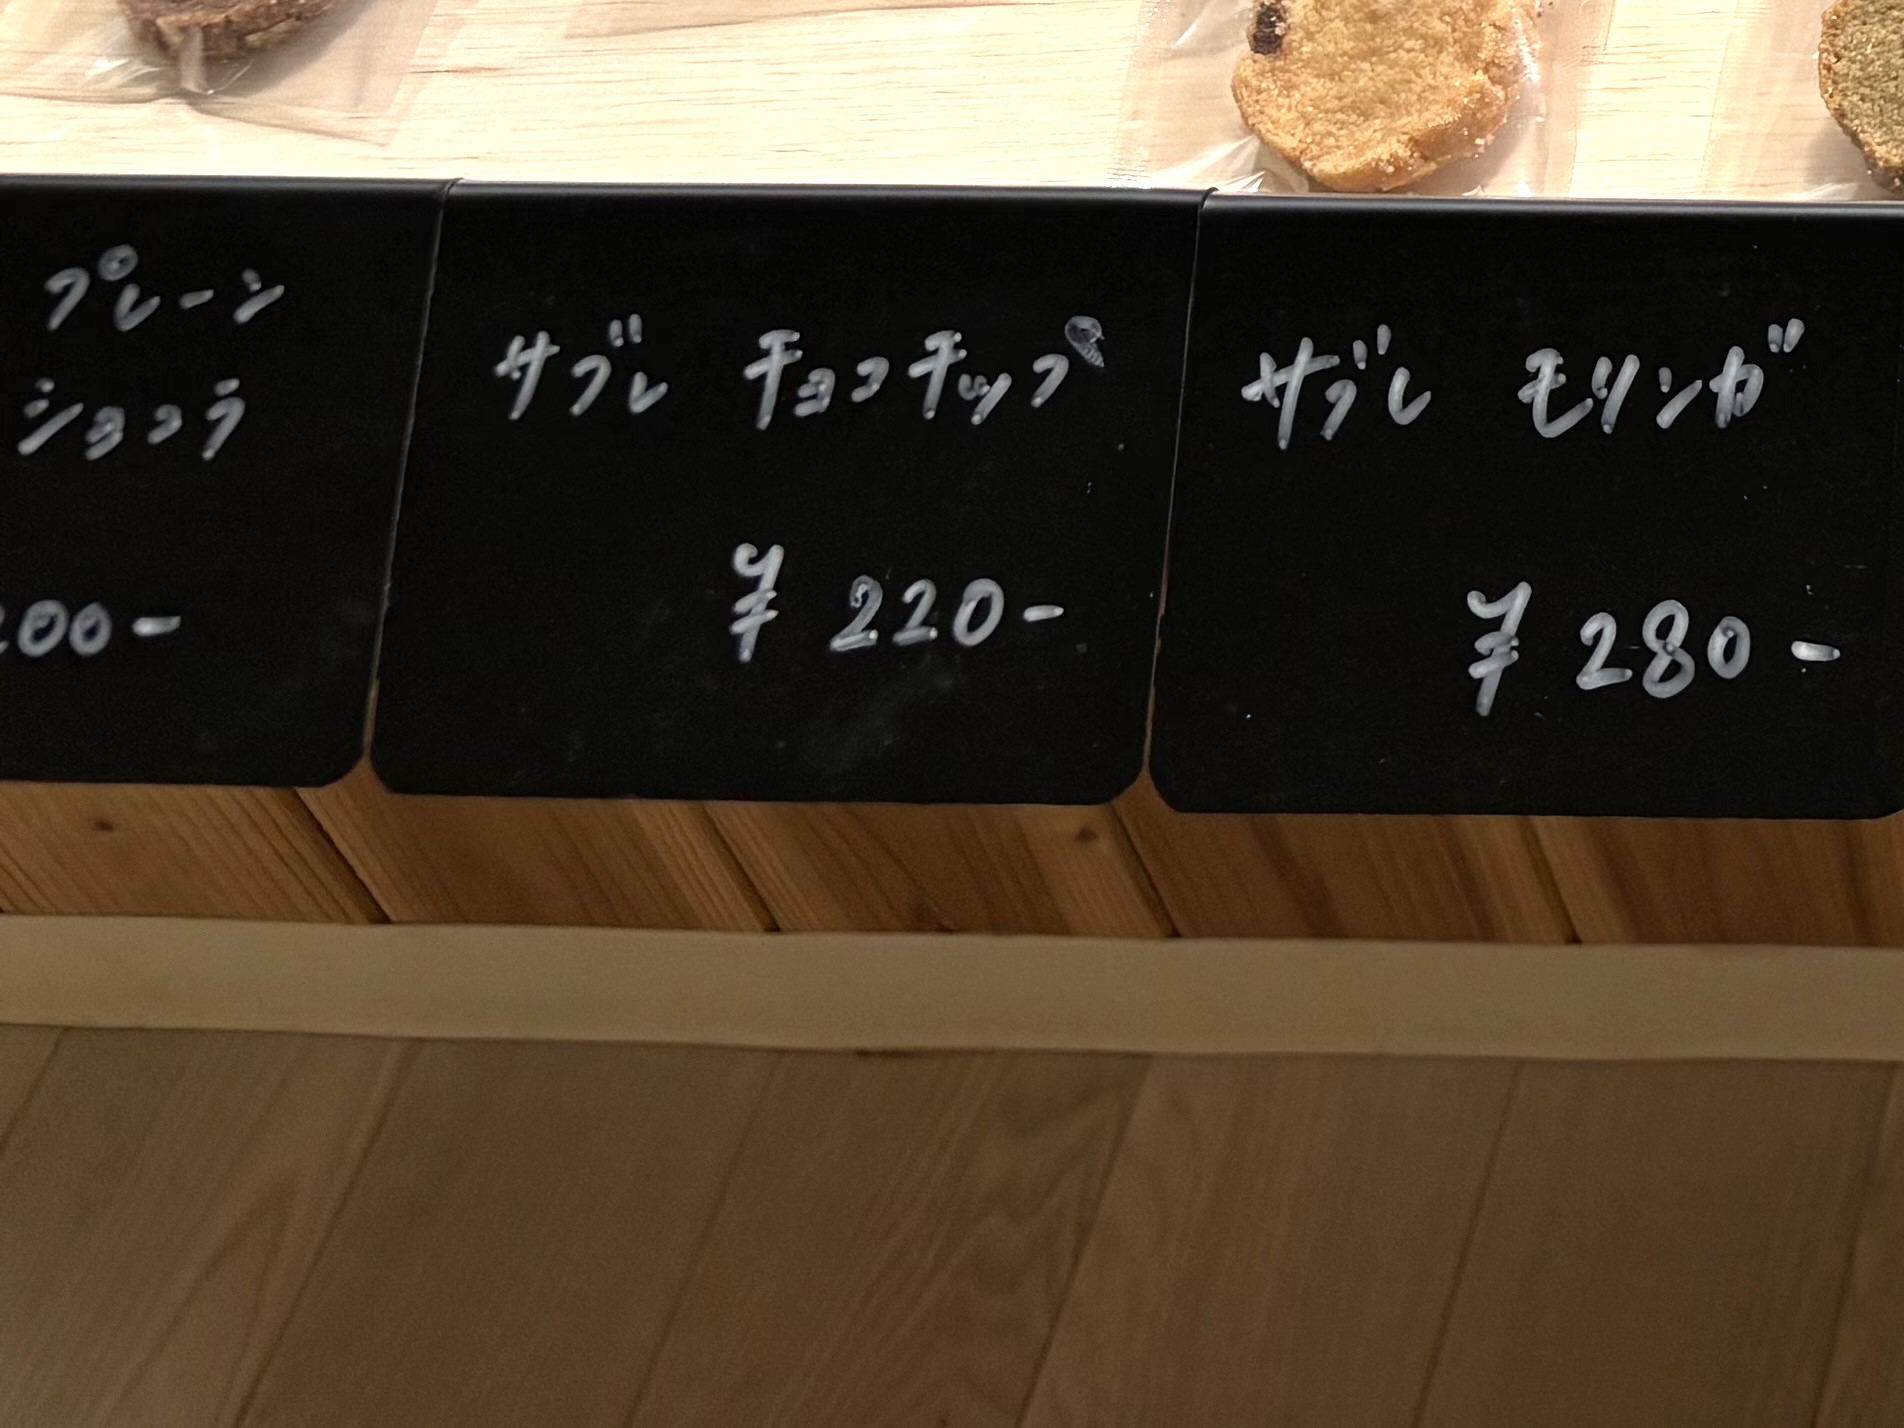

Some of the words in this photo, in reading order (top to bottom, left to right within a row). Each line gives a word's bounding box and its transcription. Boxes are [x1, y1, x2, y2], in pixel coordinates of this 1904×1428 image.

[44, 244, 285, 332] プレーン
[495, 313, 669, 421] サブレ
[743, 314, 1107, 431] チョコチップ
[1241, 322, 1431, 450] サブレ
[1516, 317, 1806, 439] モリンガ
[18, 377, 246, 461] ショコラ
[0, 600, 181, 657] 00-
